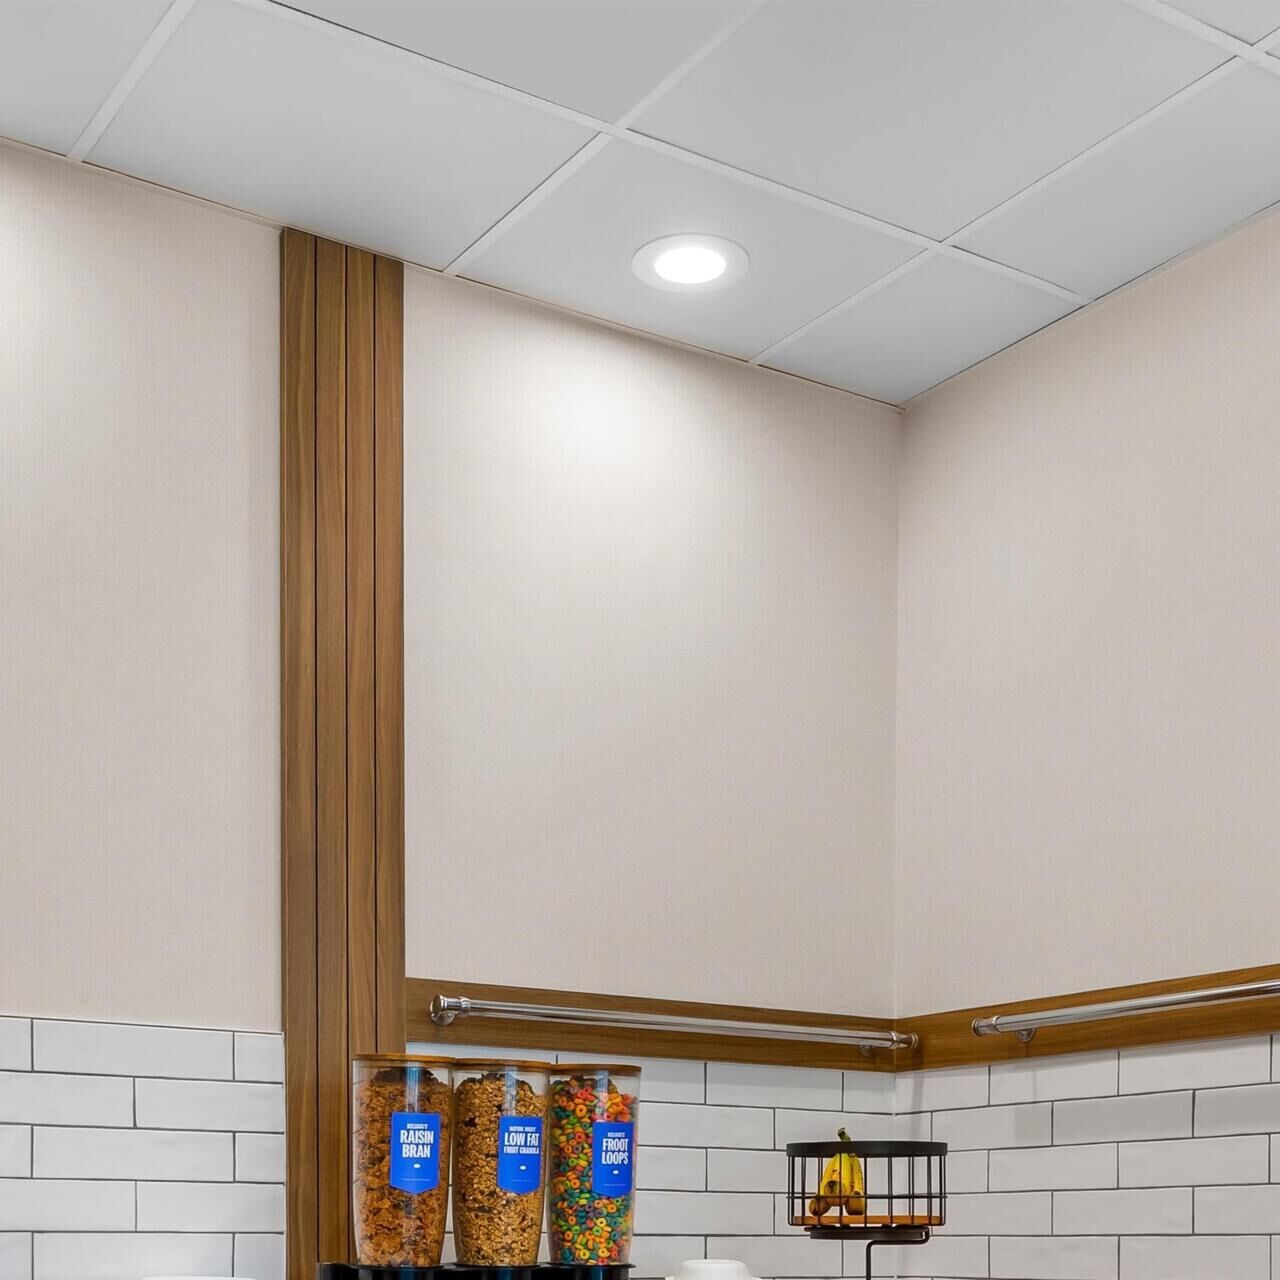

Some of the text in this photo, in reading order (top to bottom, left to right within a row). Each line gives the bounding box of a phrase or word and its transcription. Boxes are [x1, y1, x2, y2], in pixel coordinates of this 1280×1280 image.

[400, 1130, 434, 1145] RAISIN
[504, 1132, 540, 1147] LOW FAT
[602, 1138, 629, 1151] FROOT
[402, 1144, 431, 1158] BRAN
[601, 1151, 629, 1165] LOOPS
